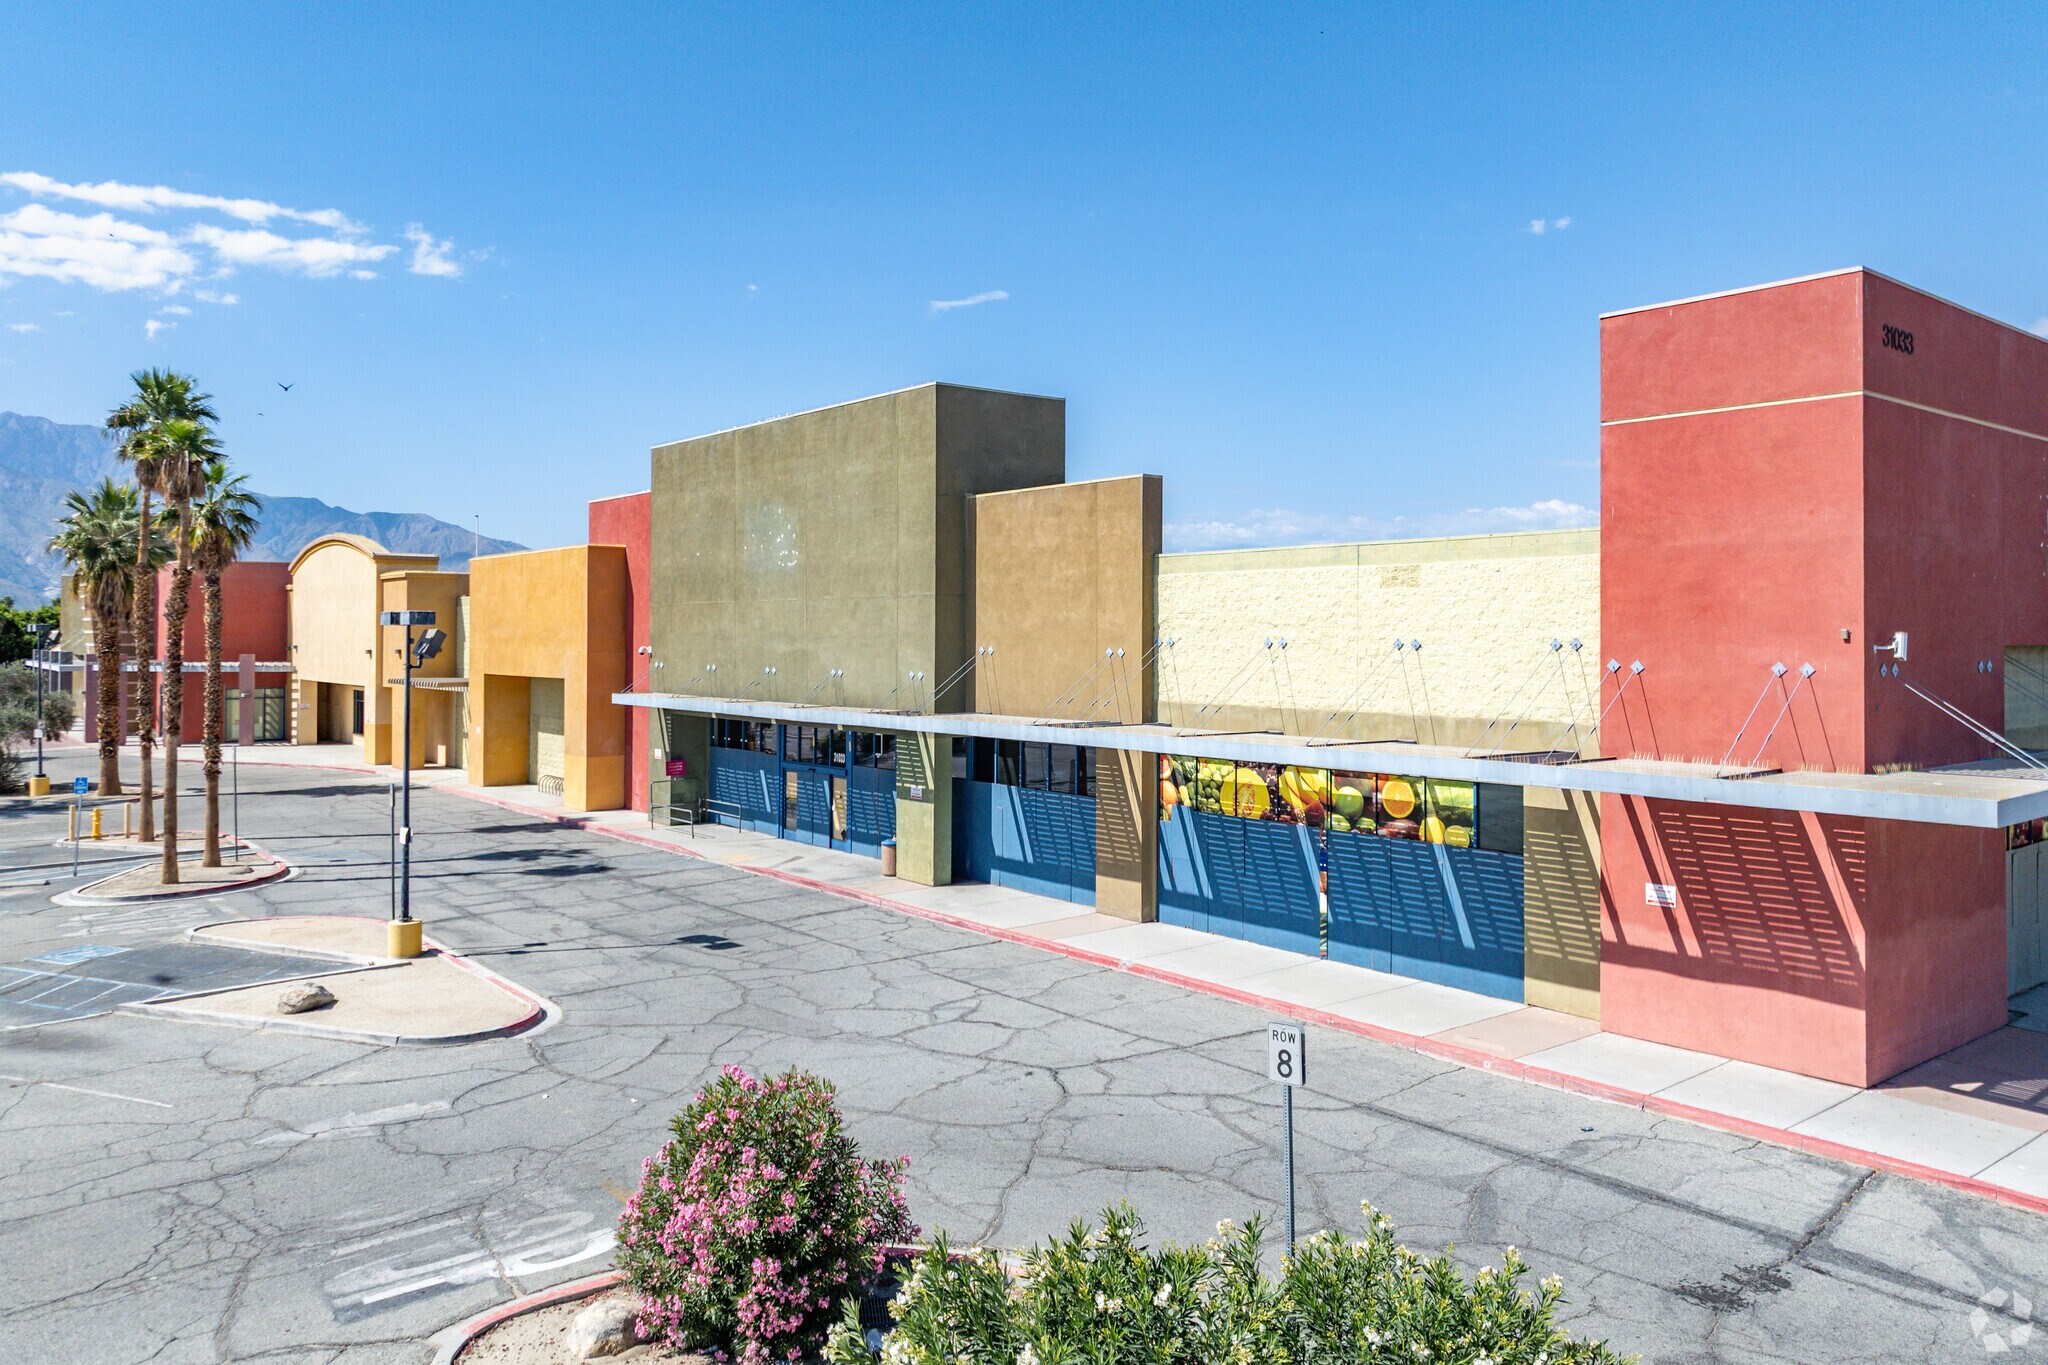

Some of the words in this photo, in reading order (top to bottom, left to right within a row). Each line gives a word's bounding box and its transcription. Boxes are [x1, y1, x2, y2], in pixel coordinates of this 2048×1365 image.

[1882, 324, 1914, 355] 31033
[1272, 1029, 1296, 1044] ROW
[1277, 1049, 1293, 1078] 8
